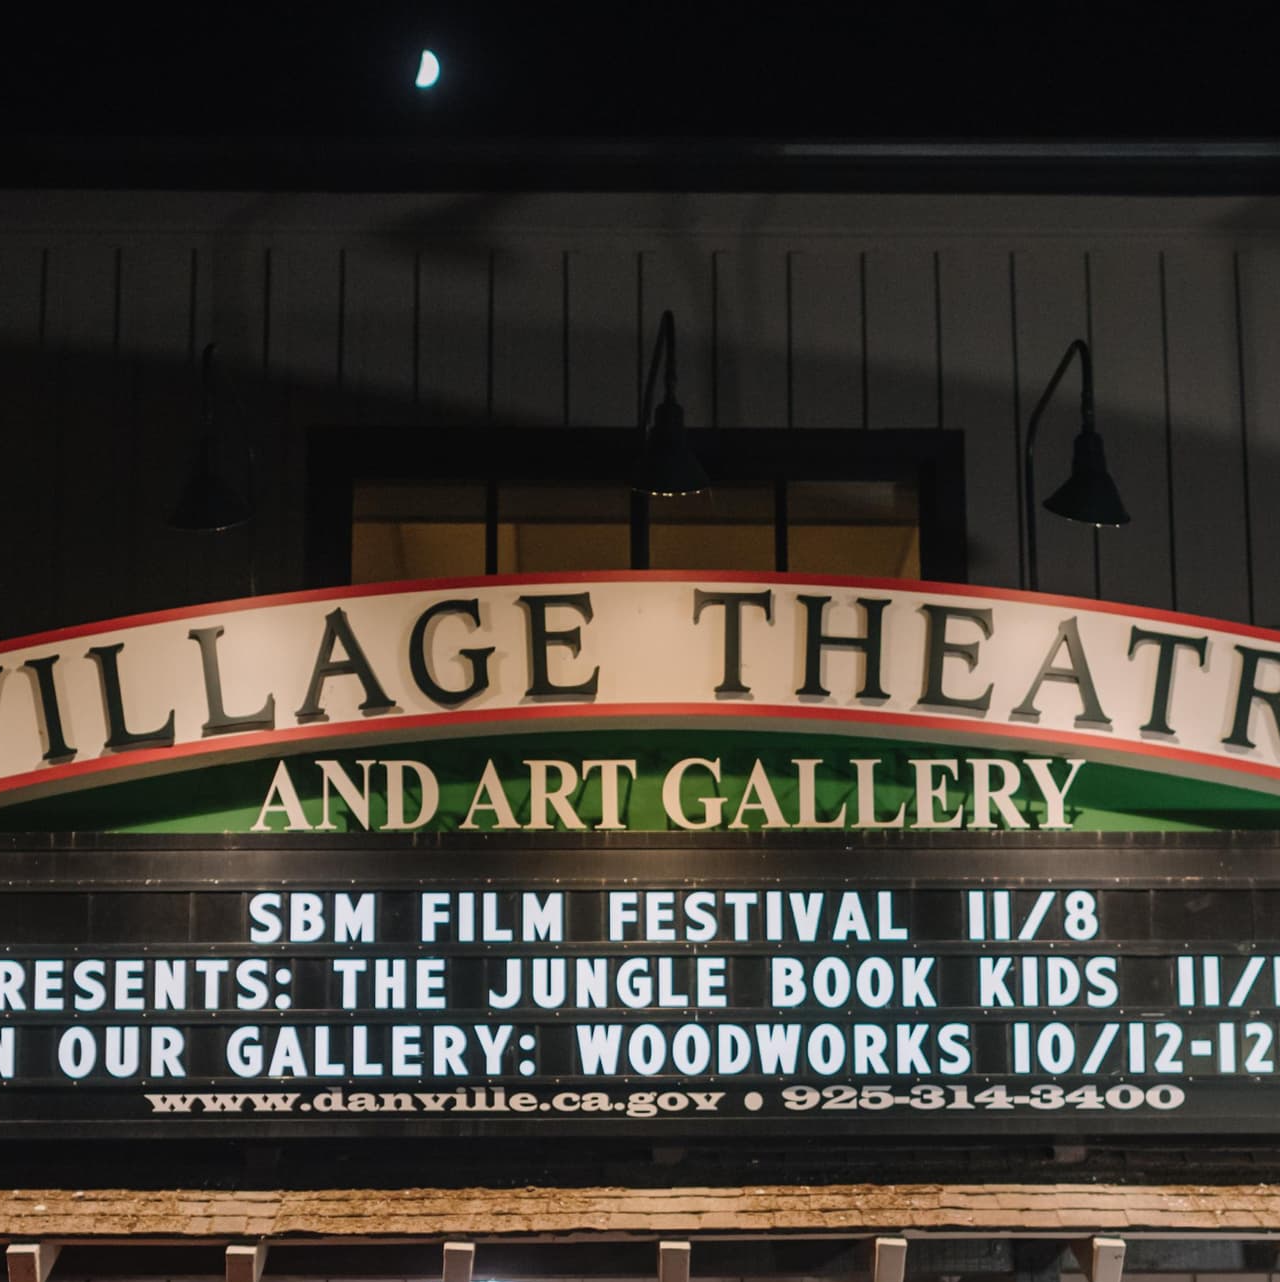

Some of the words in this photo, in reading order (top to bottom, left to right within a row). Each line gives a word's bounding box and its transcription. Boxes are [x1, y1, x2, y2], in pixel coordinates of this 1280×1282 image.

[250, 760, 440, 832] AND
[458, 759, 638, 832] ART
[661, 758, 1087, 831] GALLERY
[248, 893, 376, 944] SBM
[421, 892, 563, 943] FILM
[609, 890, 908, 943] FESTIVAL
[967, 890, 1099, 942] 11/8
[333, 959, 446, 1011] THE
[488, 956, 728, 1011] JUNGLE
[770, 957, 937, 1008] BOOK
[977, 956, 1119, 1008] KIDS
[58, 1026, 184, 1078] OUR
[226, 1025, 536, 1078] GALLERY:
[577, 1022, 973, 1076] WOODWORKS
[149, 1088, 725, 1117] www.danville.ca.gov
[782, 1083, 1185, 1112] 925-314-3400
